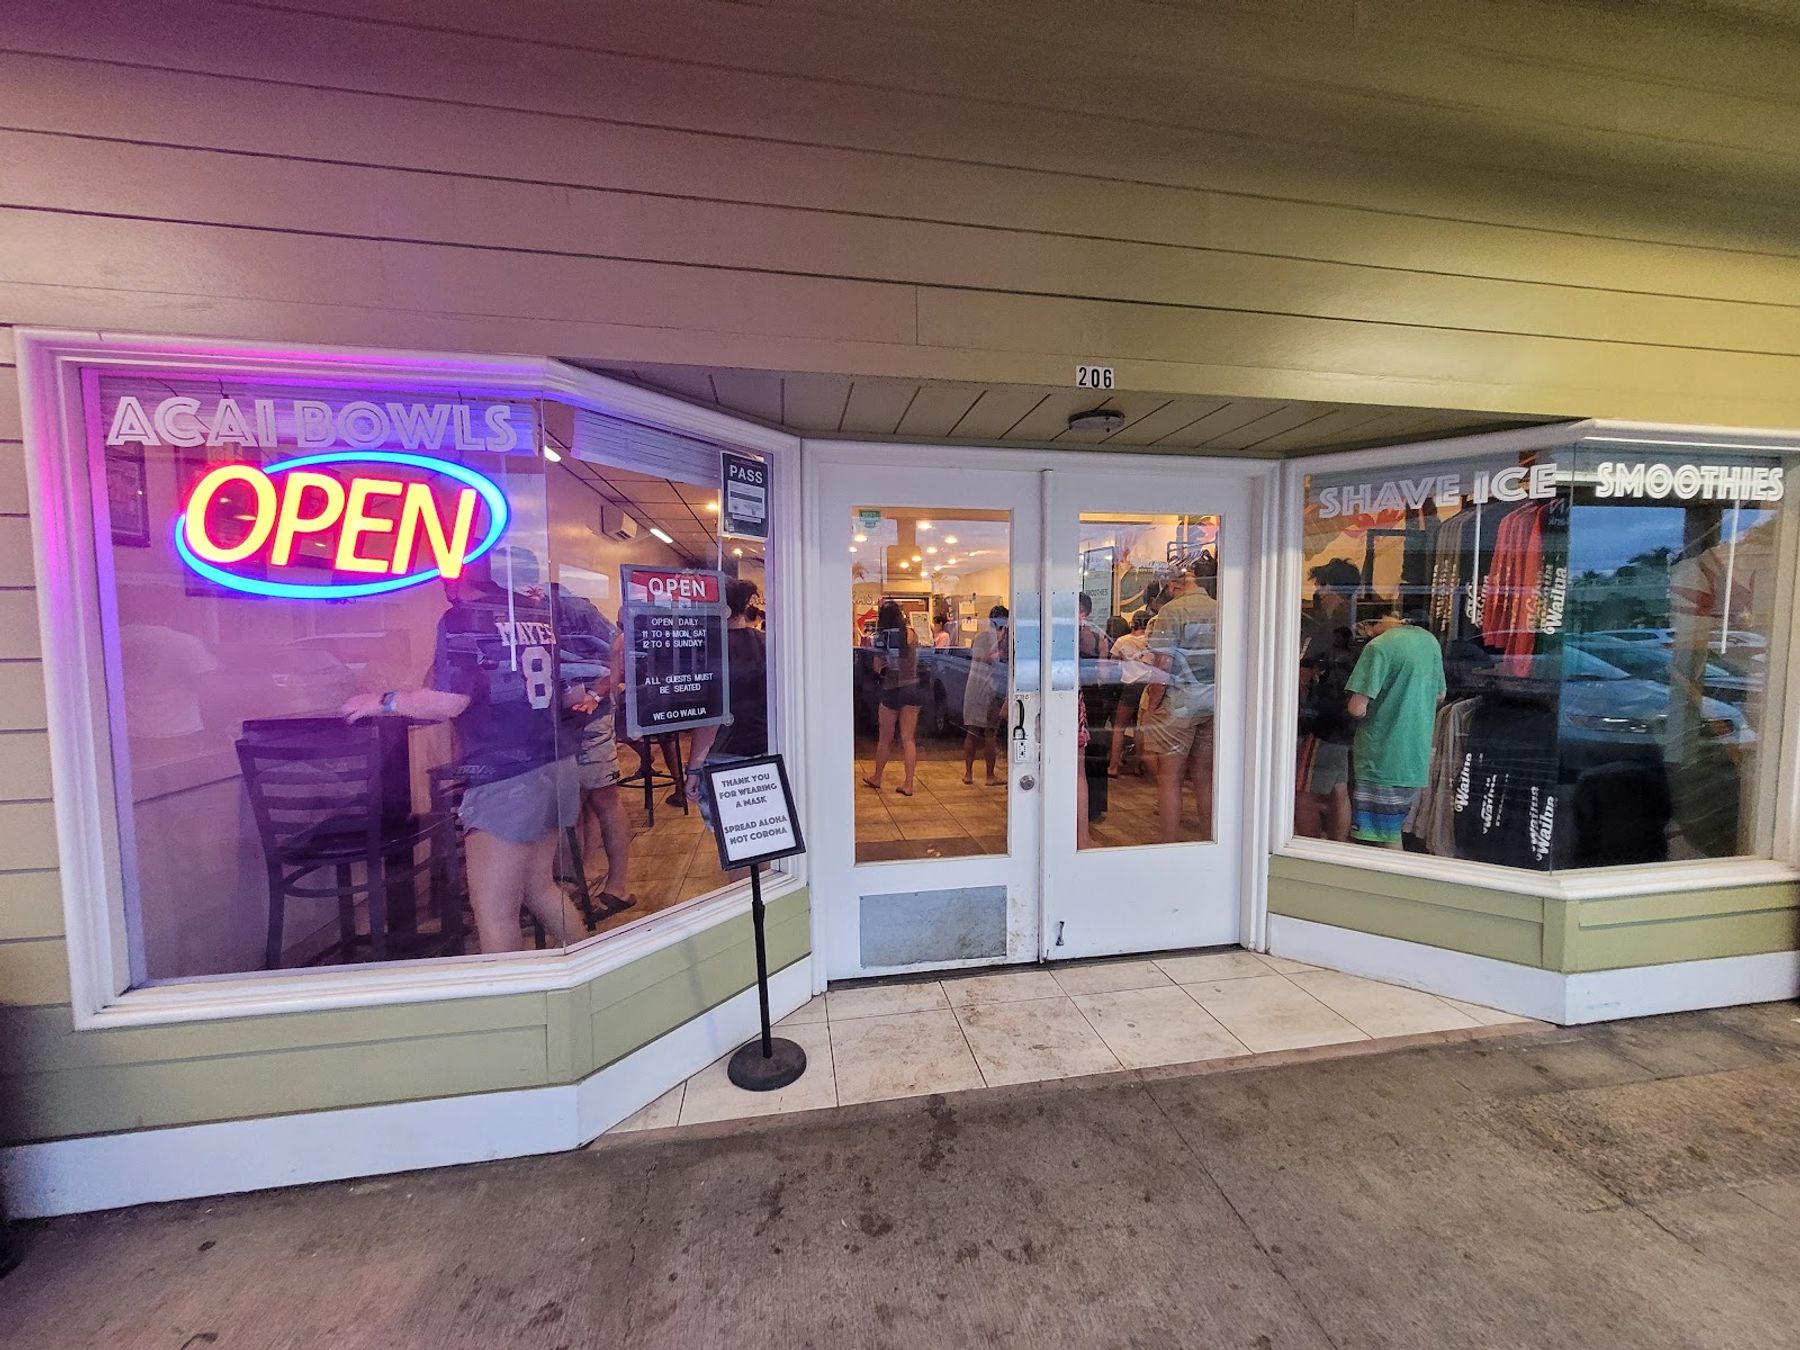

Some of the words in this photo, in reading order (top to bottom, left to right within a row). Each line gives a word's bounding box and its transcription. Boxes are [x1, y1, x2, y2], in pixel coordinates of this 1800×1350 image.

[1078, 366, 1112, 388] 206
[106, 395, 278, 448] ACAI
[293, 399, 518, 452] BOWLS
[729, 464, 763, 484] PASS
[1595, 461, 1786, 502] SMOOTHIES
[1318, 473, 1462, 518] SHAVE
[1472, 462, 1558, 504] ICE
[184, 464, 478, 580] OPEN
[648, 576, 706, 598] OPEN
[1544, 566, 1568, 635] Wailua
[651, 617, 674, 626] OPEN
[679, 617, 699, 626] DAILY
[641, 630, 649, 639] 11
[651, 630, 663, 639] TO
[665, 630, 671, 638] 8
[642, 641, 650, 649] 12
[651, 640, 663, 648] TO
[665, 639, 671, 648] 6
[673, 639, 703, 648] SUNDAY
[521, 645, 554, 710] 8
[644, 676, 661, 686] ALL
[665, 674, 692, 684] GUESTS
[694, 672, 714, 682] MUST
[659, 686, 670, 695] BE
[674, 684, 701, 694] SEATED
[652, 711, 666, 721] WE
[667, 709, 680, 719] GO
[680, 707, 707, 718] WAILUA
[721, 776, 751, 788] THANK
[751, 772, 770, 782] YOU
[719, 790, 737, 800] FOR
[738, 782, 778, 796] WEARING
[735, 800, 743, 808] A
[743, 795, 768, 807] MASK
[724, 821, 757, 834] SPREAD
[758, 815, 788, 827] ALOHA
[729, 834, 749, 845] NOT
[749, 826, 788, 841] CORONA
